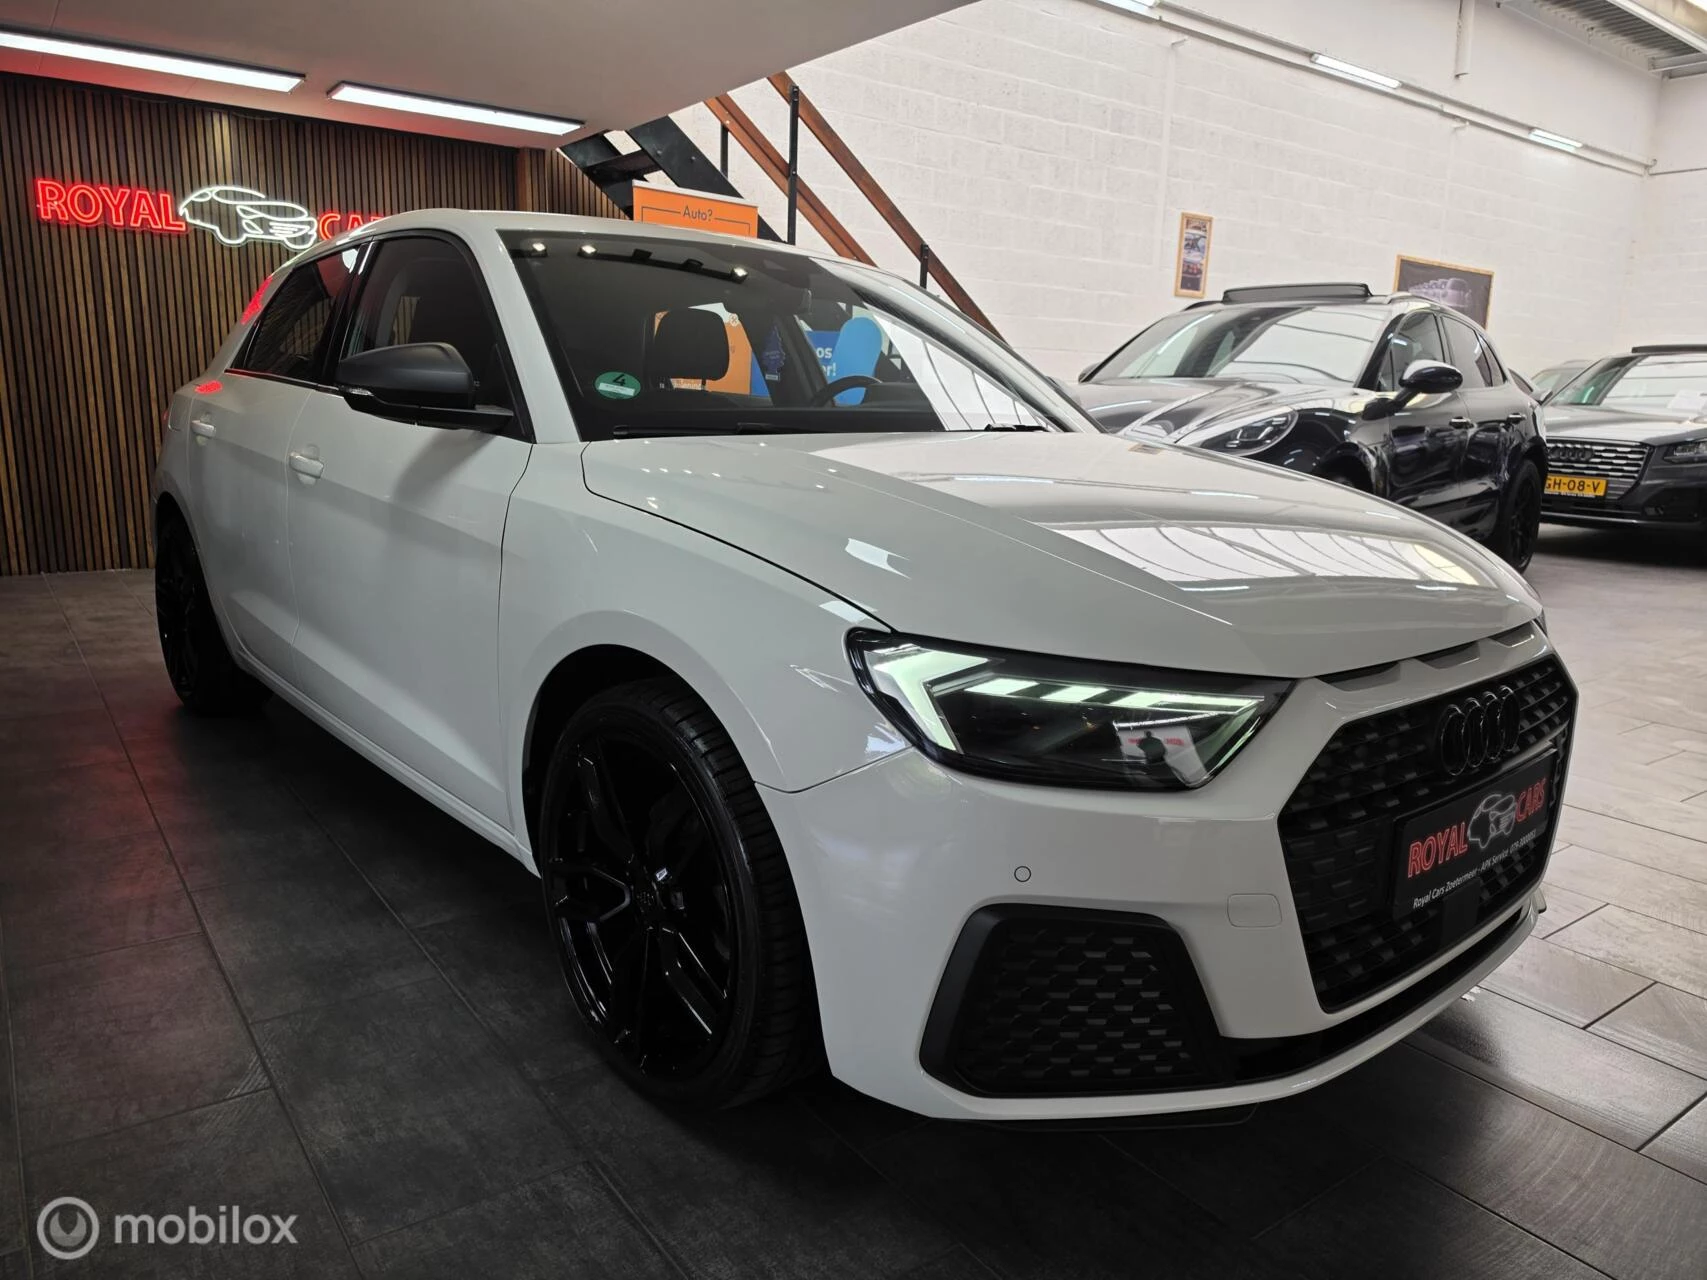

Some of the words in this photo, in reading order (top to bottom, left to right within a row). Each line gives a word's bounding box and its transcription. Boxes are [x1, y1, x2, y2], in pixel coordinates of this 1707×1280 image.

[37, 179, 187, 232] ROYAL
[683, 205, 713, 221] Auto?
[613, 374, 625, 386] 4
[1408, 822, 1468, 878] ROYAL
[1515, 778, 1545, 822] CARS
[1413, 890, 1431, 909] Royal
[1432, 886, 1445, 899] Cars
